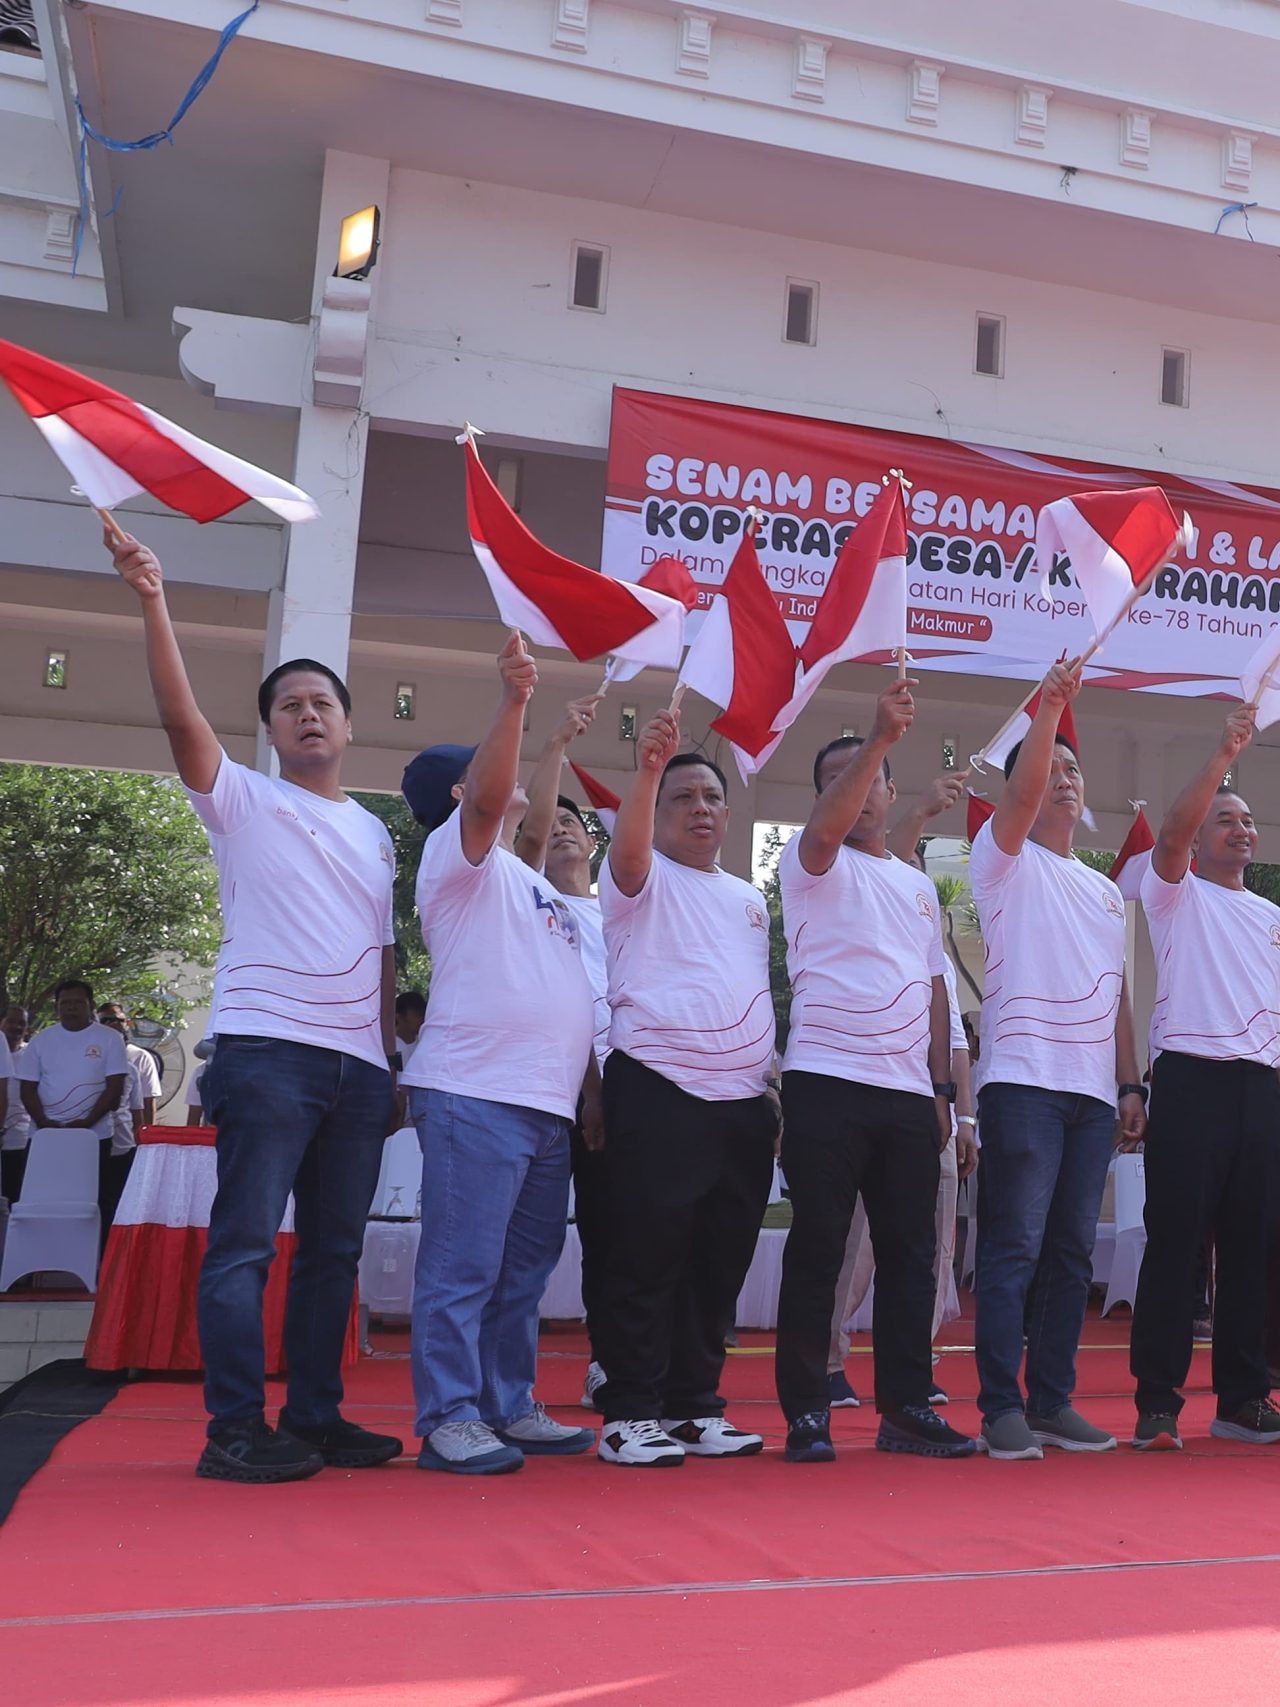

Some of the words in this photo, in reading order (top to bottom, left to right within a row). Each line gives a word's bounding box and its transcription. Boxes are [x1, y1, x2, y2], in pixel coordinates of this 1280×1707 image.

[644, 453, 813, 510] SENAM
[824, 477, 1036, 539] BESAMA
[1208, 531, 1237, 565] &
[645, 499, 858, 559] KOPERAS
[1013, 546, 1035, 583] /
[910, 611, 975, 635] Makmur
[971, 585, 1016, 609] Hari
[1023, 593, 1088, 620] Koper
[1127, 607, 1190, 630] ke-78
[1197, 613, 1262, 638] Tahun
